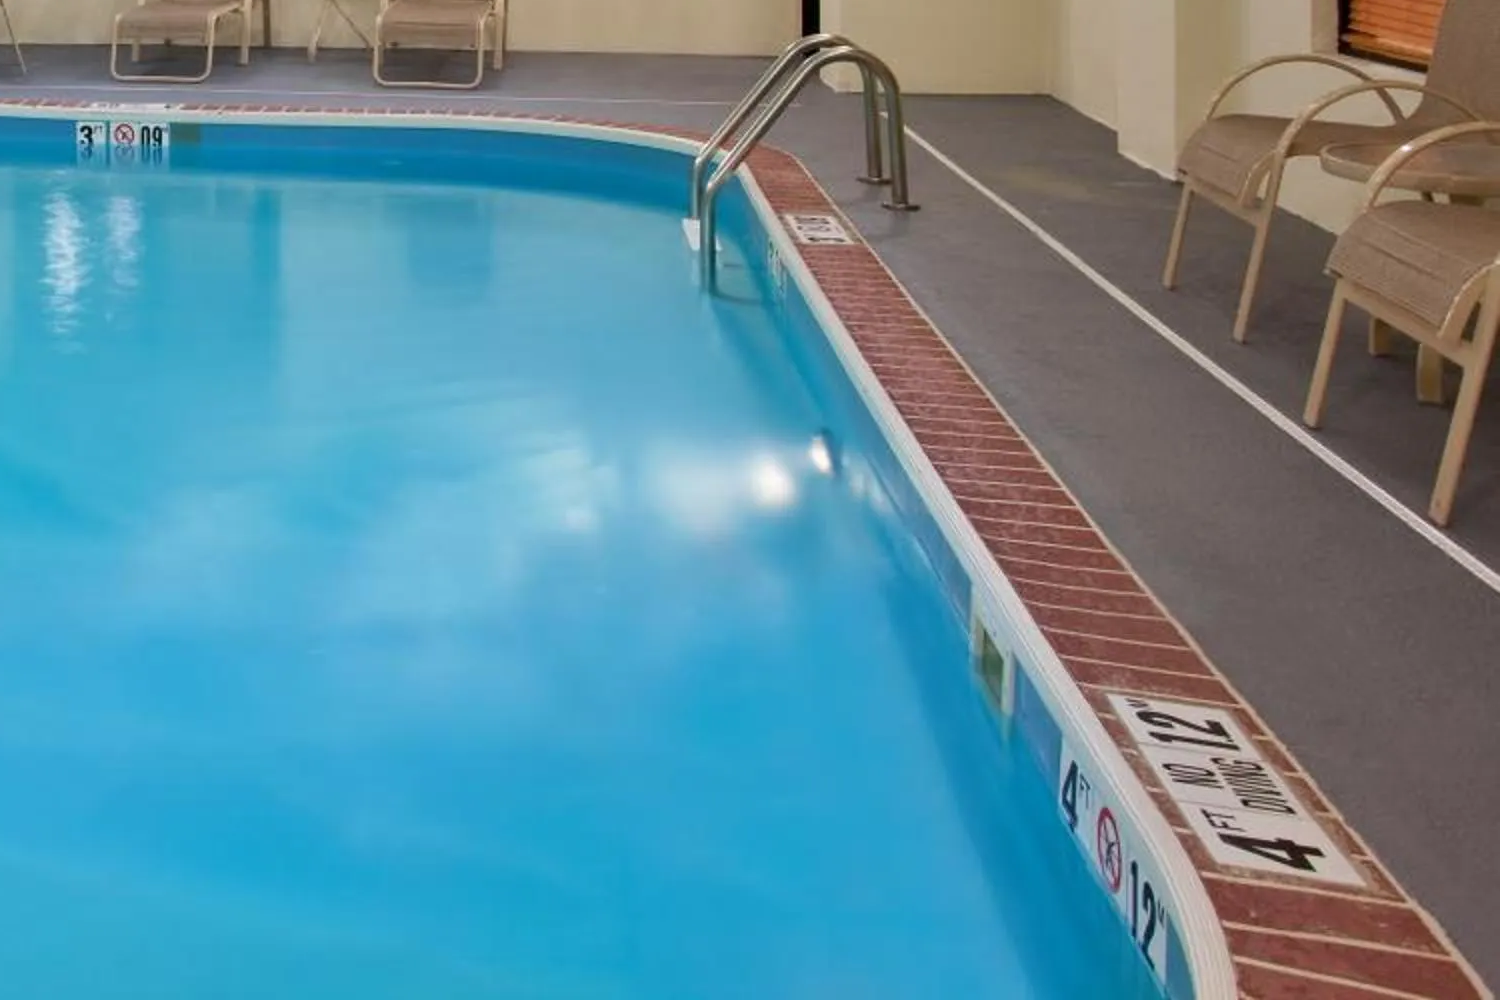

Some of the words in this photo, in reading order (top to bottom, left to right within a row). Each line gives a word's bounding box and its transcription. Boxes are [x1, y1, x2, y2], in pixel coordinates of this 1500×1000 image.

[1062, 760, 1079, 833] 4
[1163, 762, 1225, 790] NO
[1210, 756, 1296, 816] DIVING
[1200, 807, 1248, 833] FT
[1217, 831, 1326, 873] 4
